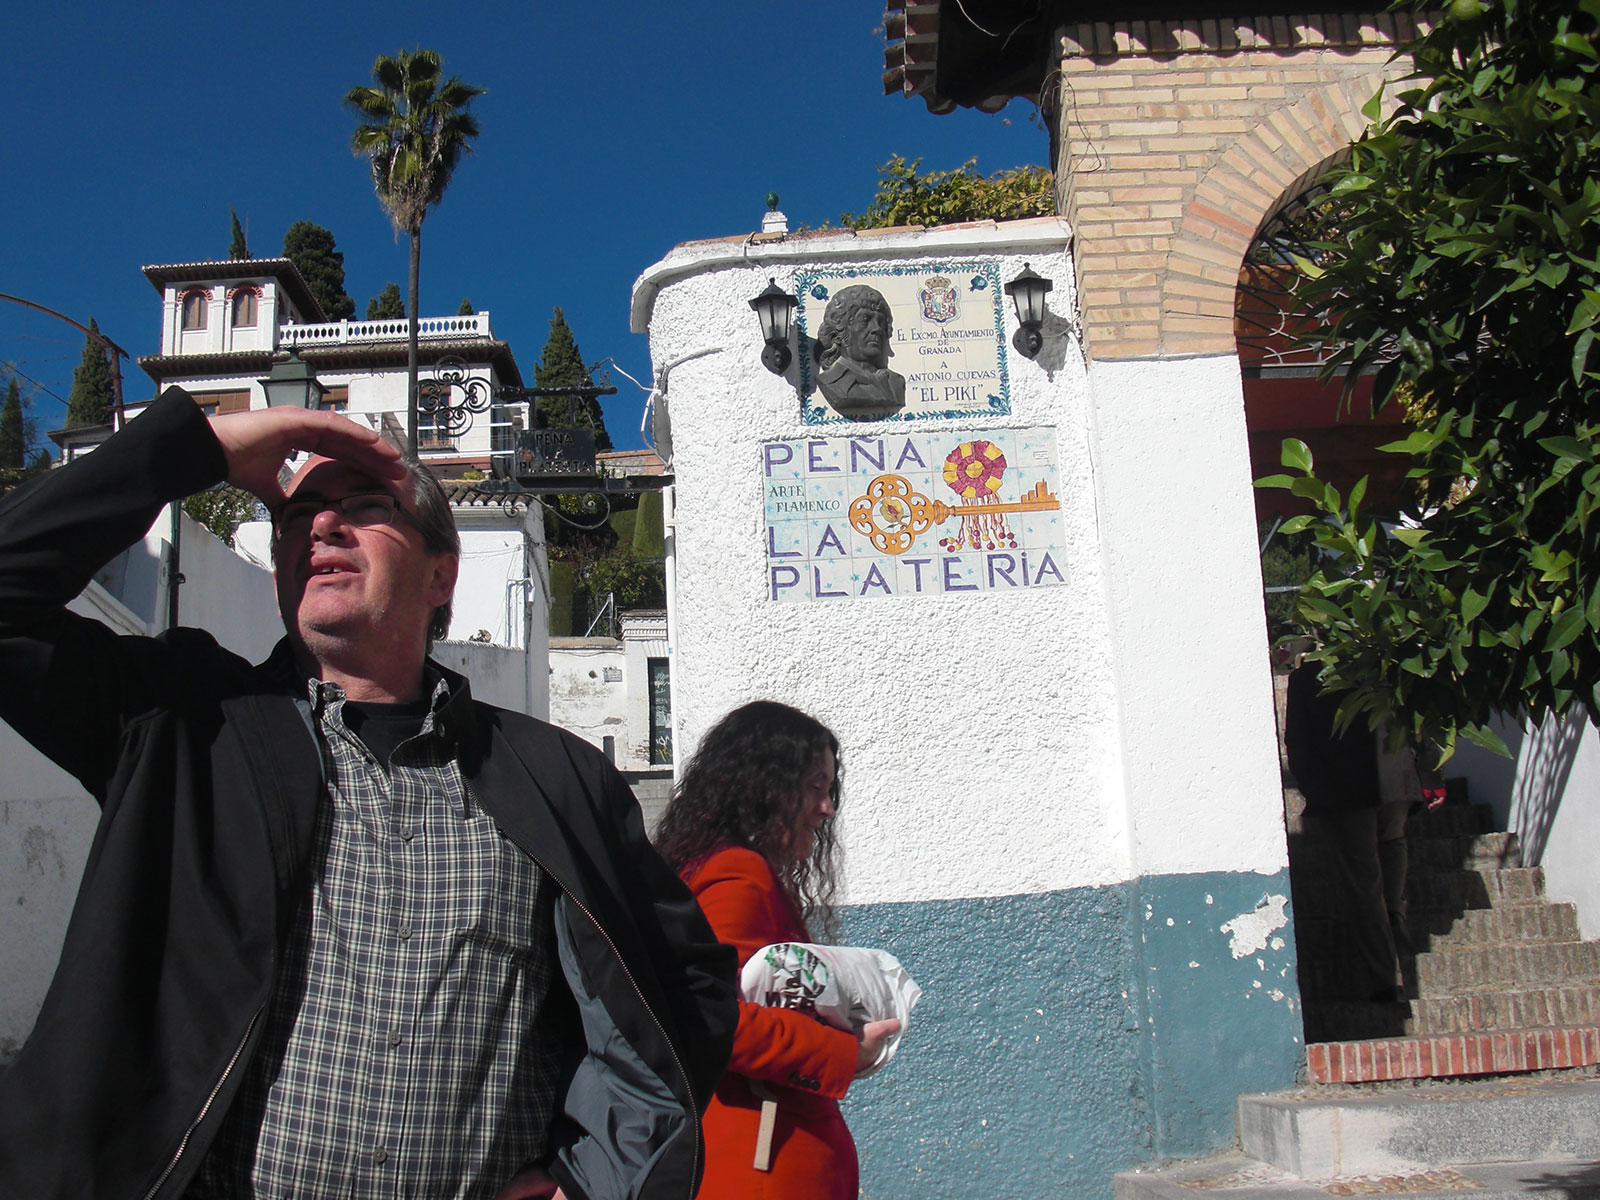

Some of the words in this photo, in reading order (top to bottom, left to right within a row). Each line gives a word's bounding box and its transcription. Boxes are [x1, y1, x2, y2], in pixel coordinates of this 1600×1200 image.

[897, 328, 907, 341] EL
[940, 327, 995, 339] AYUNTAMIENTO
[918, 346, 962, 355] GRANADA
[940, 361, 948, 369] A
[908, 372, 952, 382] ANTONIO
[956, 370, 997, 380] CUEVAS
[764, 436, 927, 477] PEÑA
[768, 485, 805, 498] ARTE
[776, 500, 840, 512] FLAMENCO
[768, 523, 847, 558] LA
